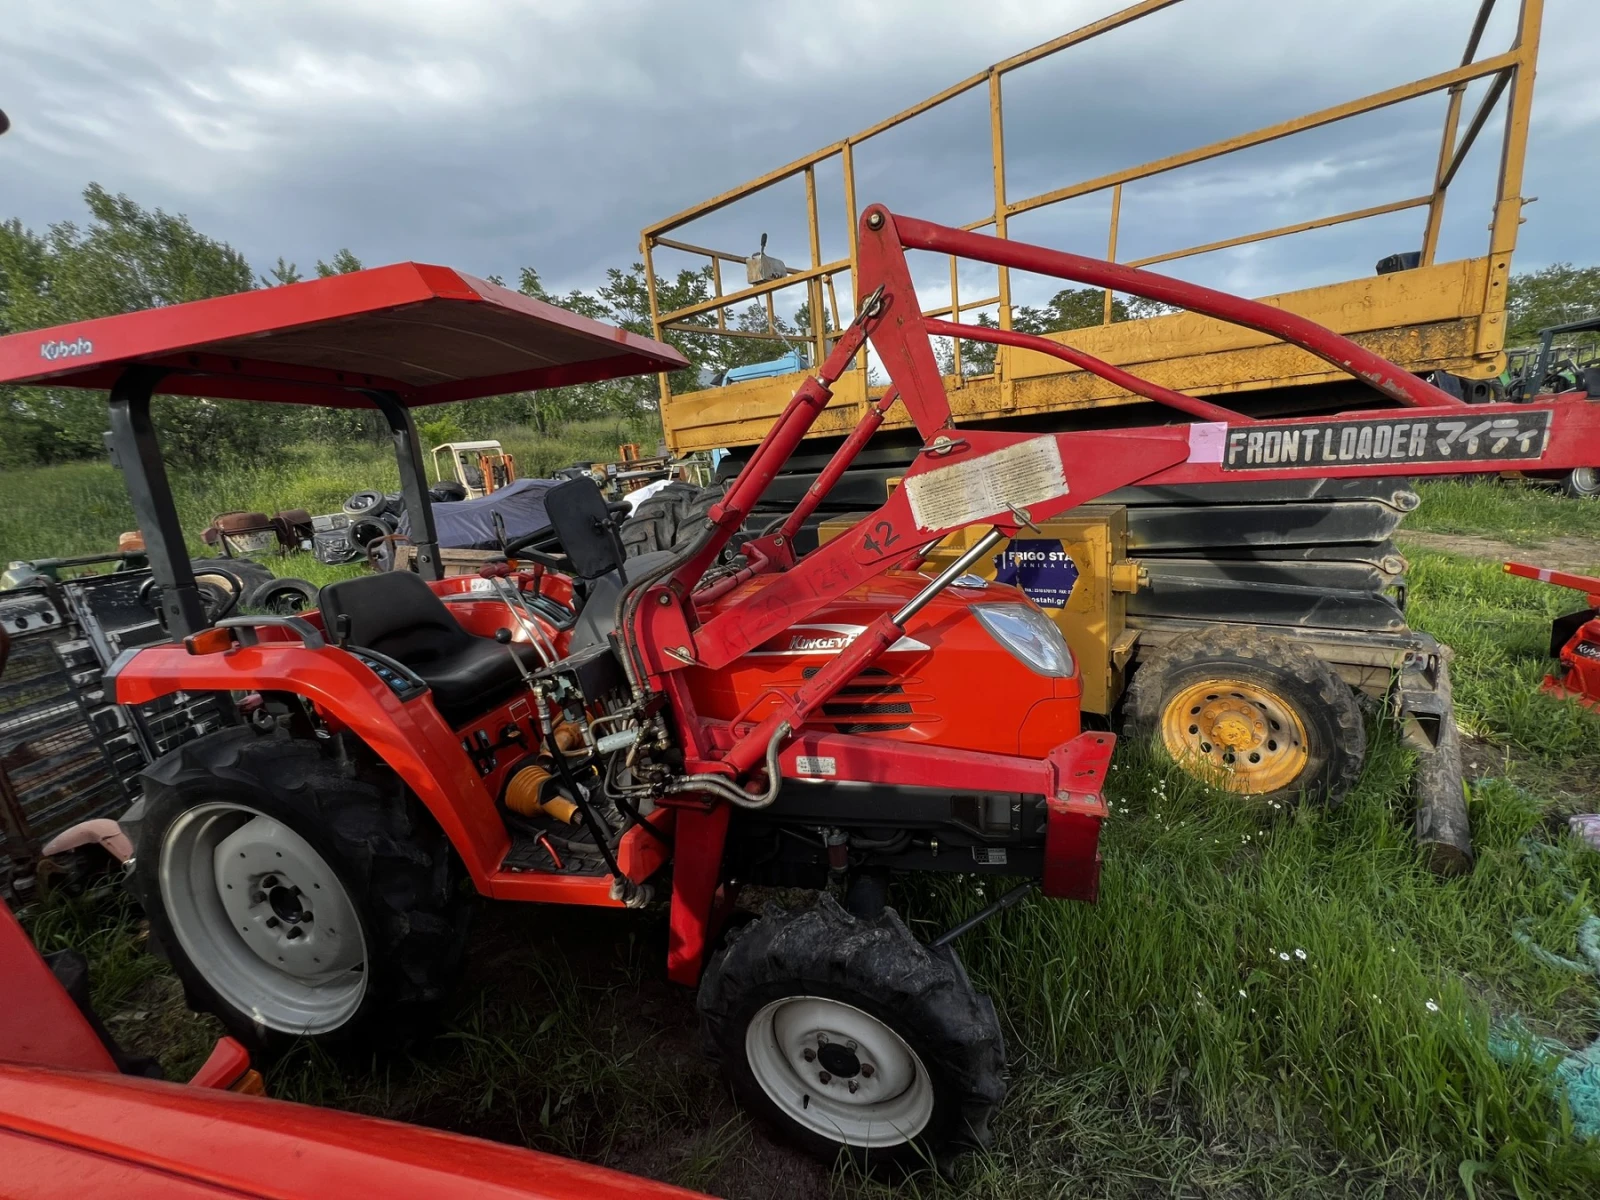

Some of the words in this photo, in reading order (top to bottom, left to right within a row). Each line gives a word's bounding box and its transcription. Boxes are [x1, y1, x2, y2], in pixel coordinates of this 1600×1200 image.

[40, 337, 93, 360] Kubota
[1228, 428, 1320, 465] FRONT
[1323, 423, 1429, 461] LOADER
[1435, 418, 1539, 456] マイティ
[1008, 551, 1046, 561] FRIGO
